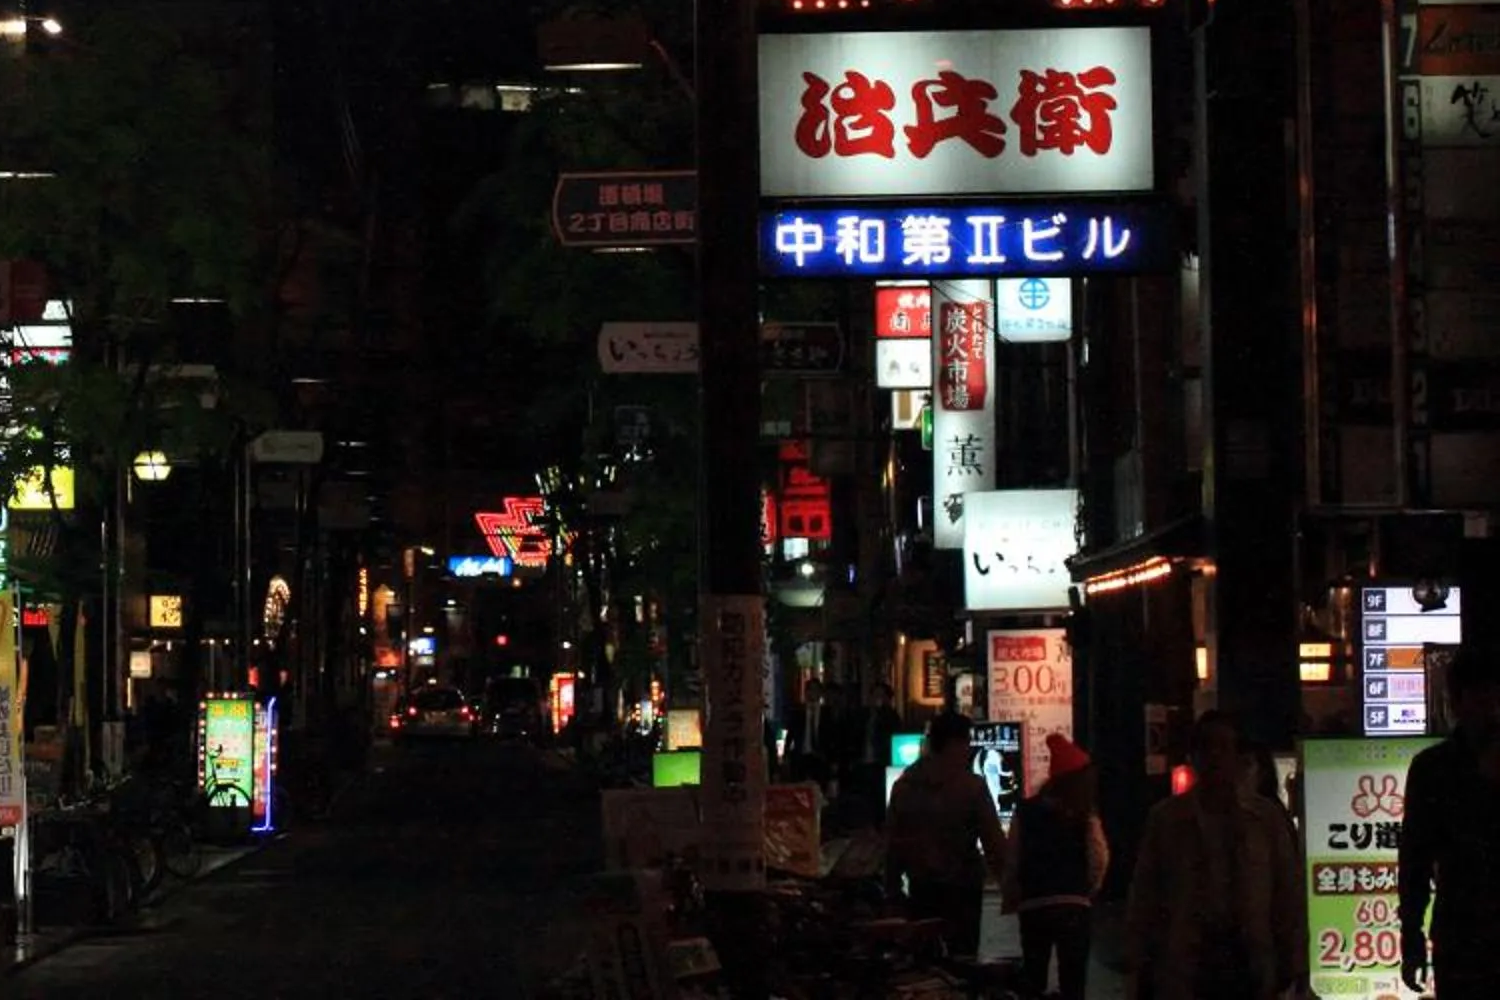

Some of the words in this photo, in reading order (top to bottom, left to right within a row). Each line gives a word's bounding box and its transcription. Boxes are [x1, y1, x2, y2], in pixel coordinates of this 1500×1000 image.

[795, 65, 1117, 159] 治兵衛
[1368, 652, 1385, 666] 7F
[1369, 681, 1385, 695] 6F
[1369, 710, 1385, 724] 5F
[1317, 866, 1399, 892] 全身もみ
[1320, 930, 1399, 967] 2,80
